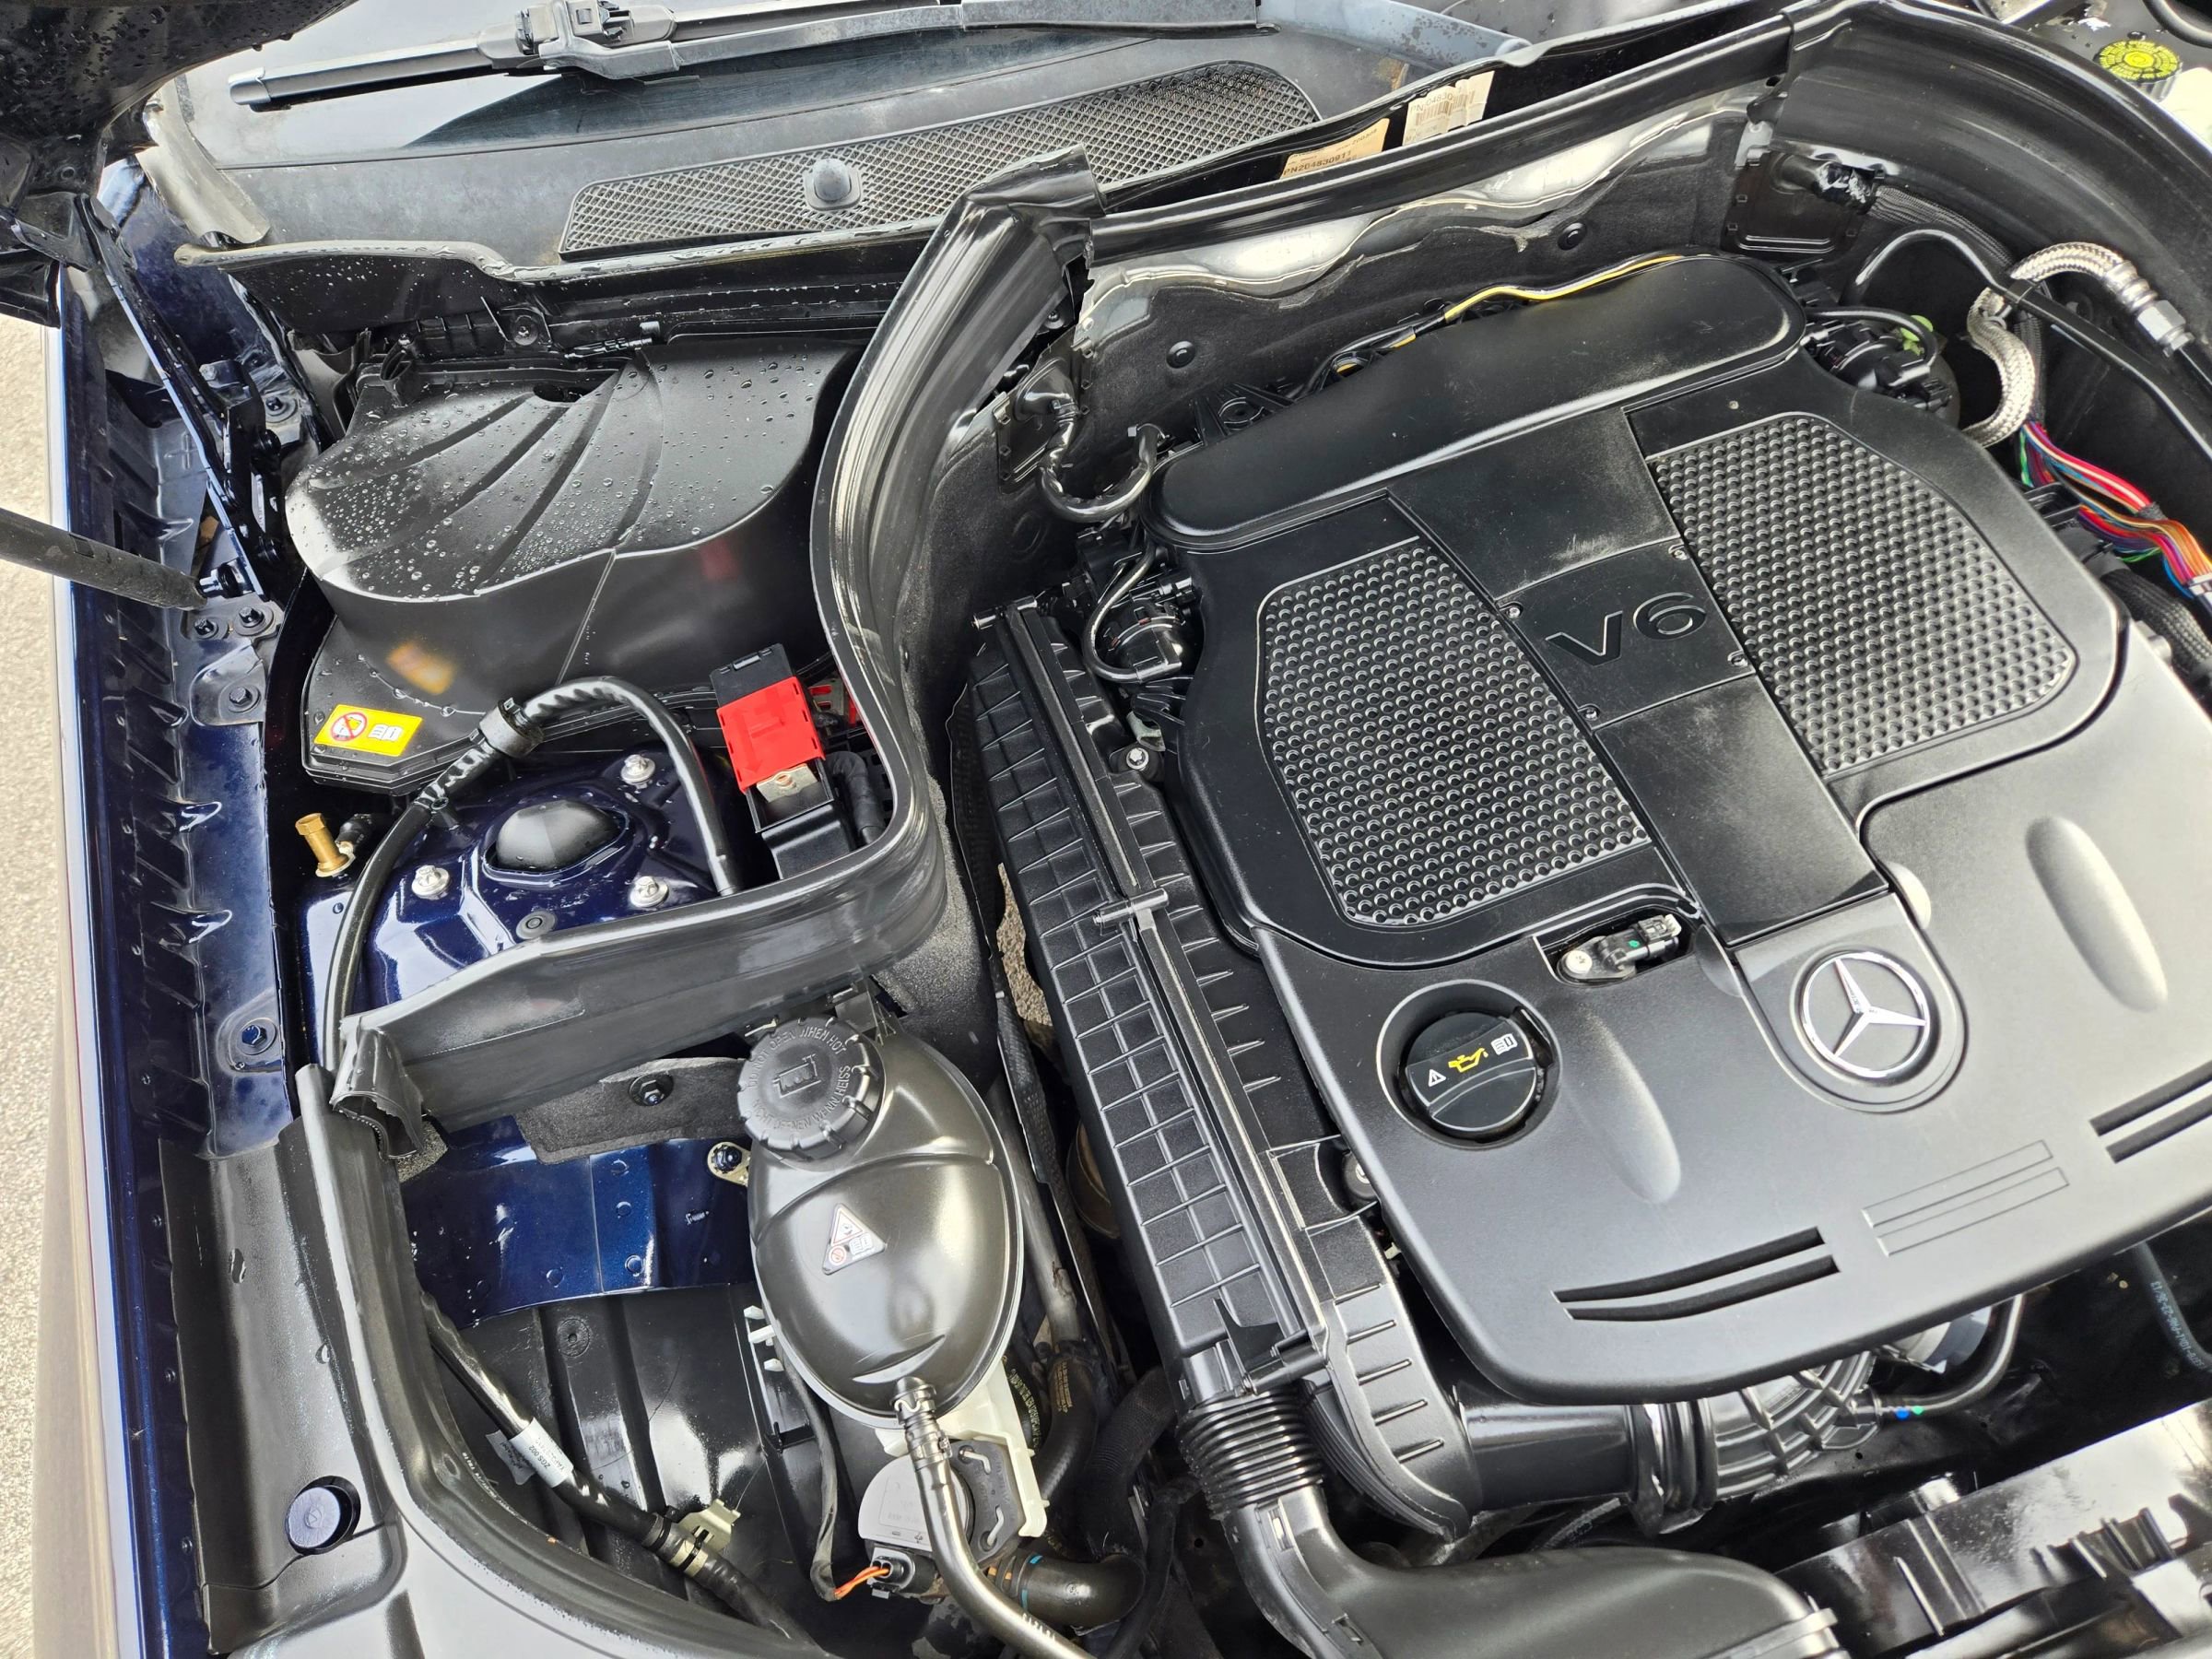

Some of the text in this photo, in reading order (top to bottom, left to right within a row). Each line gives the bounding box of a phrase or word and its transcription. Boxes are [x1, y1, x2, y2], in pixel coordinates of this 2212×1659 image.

[1544, 591, 1708, 668] V6
[753, 1049, 771, 1070] NOT
[770, 1030, 796, 1051] OPEN
[799, 1026, 830, 1041] WHEN
[826, 1034, 847, 1055] HOT
[811, 1096, 841, 1123] WENN
[833, 1065, 851, 1097] HEISS
[528, 1445, 540, 1456] 002
[537, 1456, 551, 1469] ZGS
